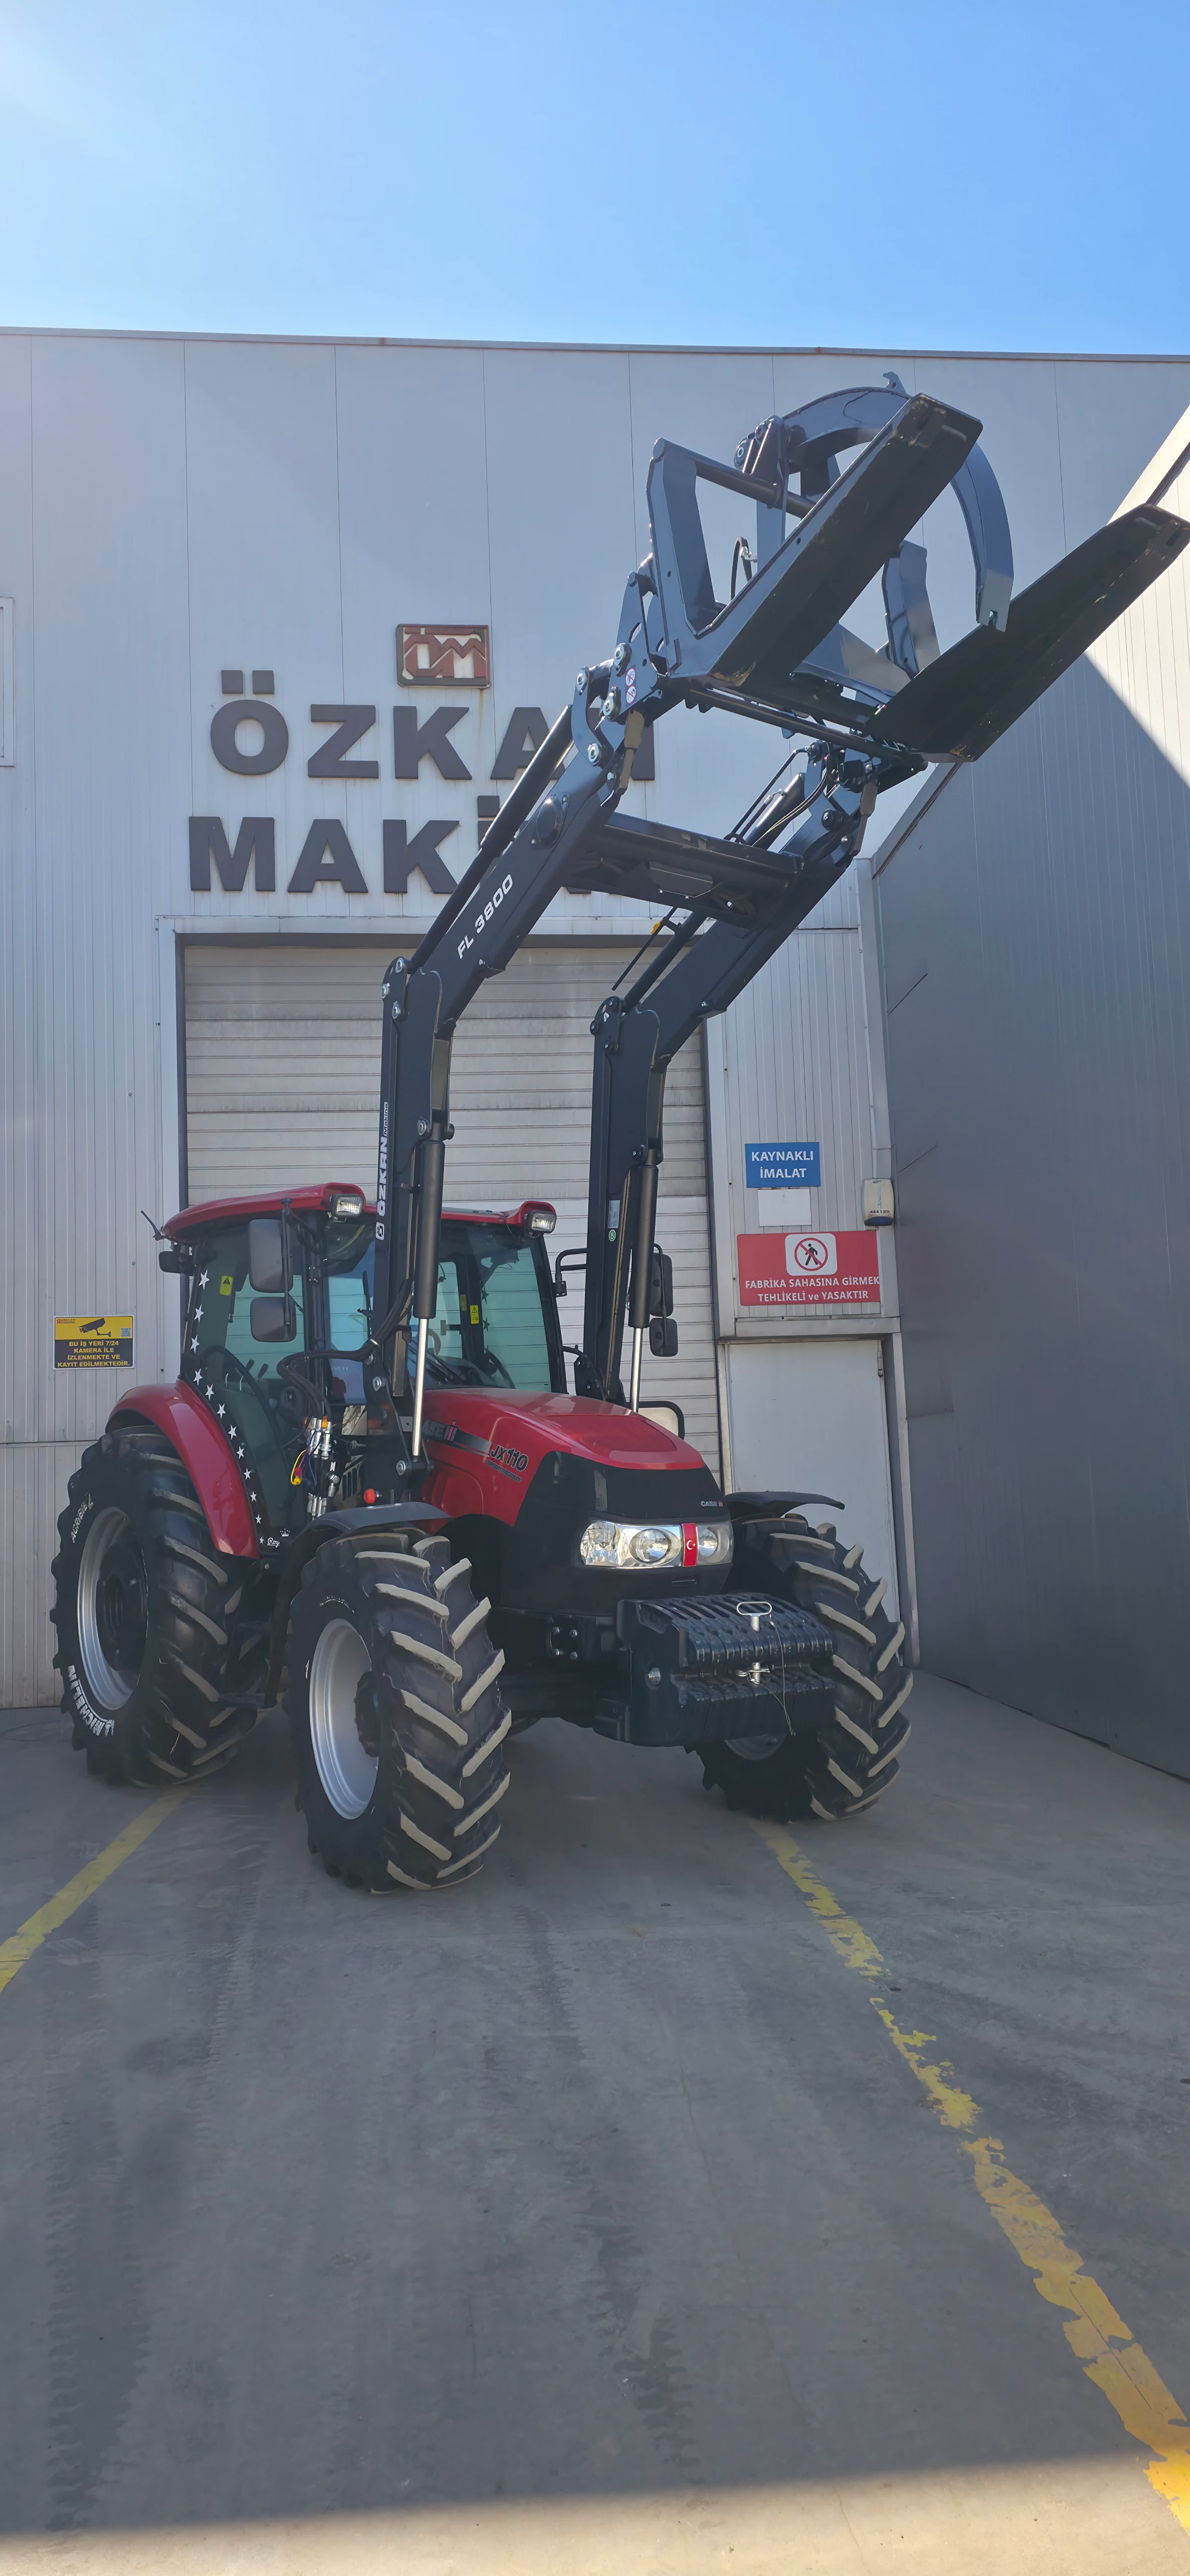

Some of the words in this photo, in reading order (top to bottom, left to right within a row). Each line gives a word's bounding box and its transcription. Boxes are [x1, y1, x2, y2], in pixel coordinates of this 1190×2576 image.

[457, 935, 474, 959] FL
[475, 874, 513, 934] 3800
[751, 1150, 814, 1161] KAYNAKLI
[377, 1137, 387, 1216] ÖZKAN
[760, 1166, 807, 1178] İMALAT
[745, 1278, 786, 1289] FABRİKA
[789, 1277, 839, 1287] SAHASINA
[842, 1275, 880, 1286] GİRMEK
[758, 1292, 806, 1302] TEHLİKELİ
[822, 1291, 869, 1300] YASAKTIR
[422, 1420, 446, 1437] ASE
[490, 1444, 529, 1472] JX110
[67, 1665, 106, 1736] MICHELIN
